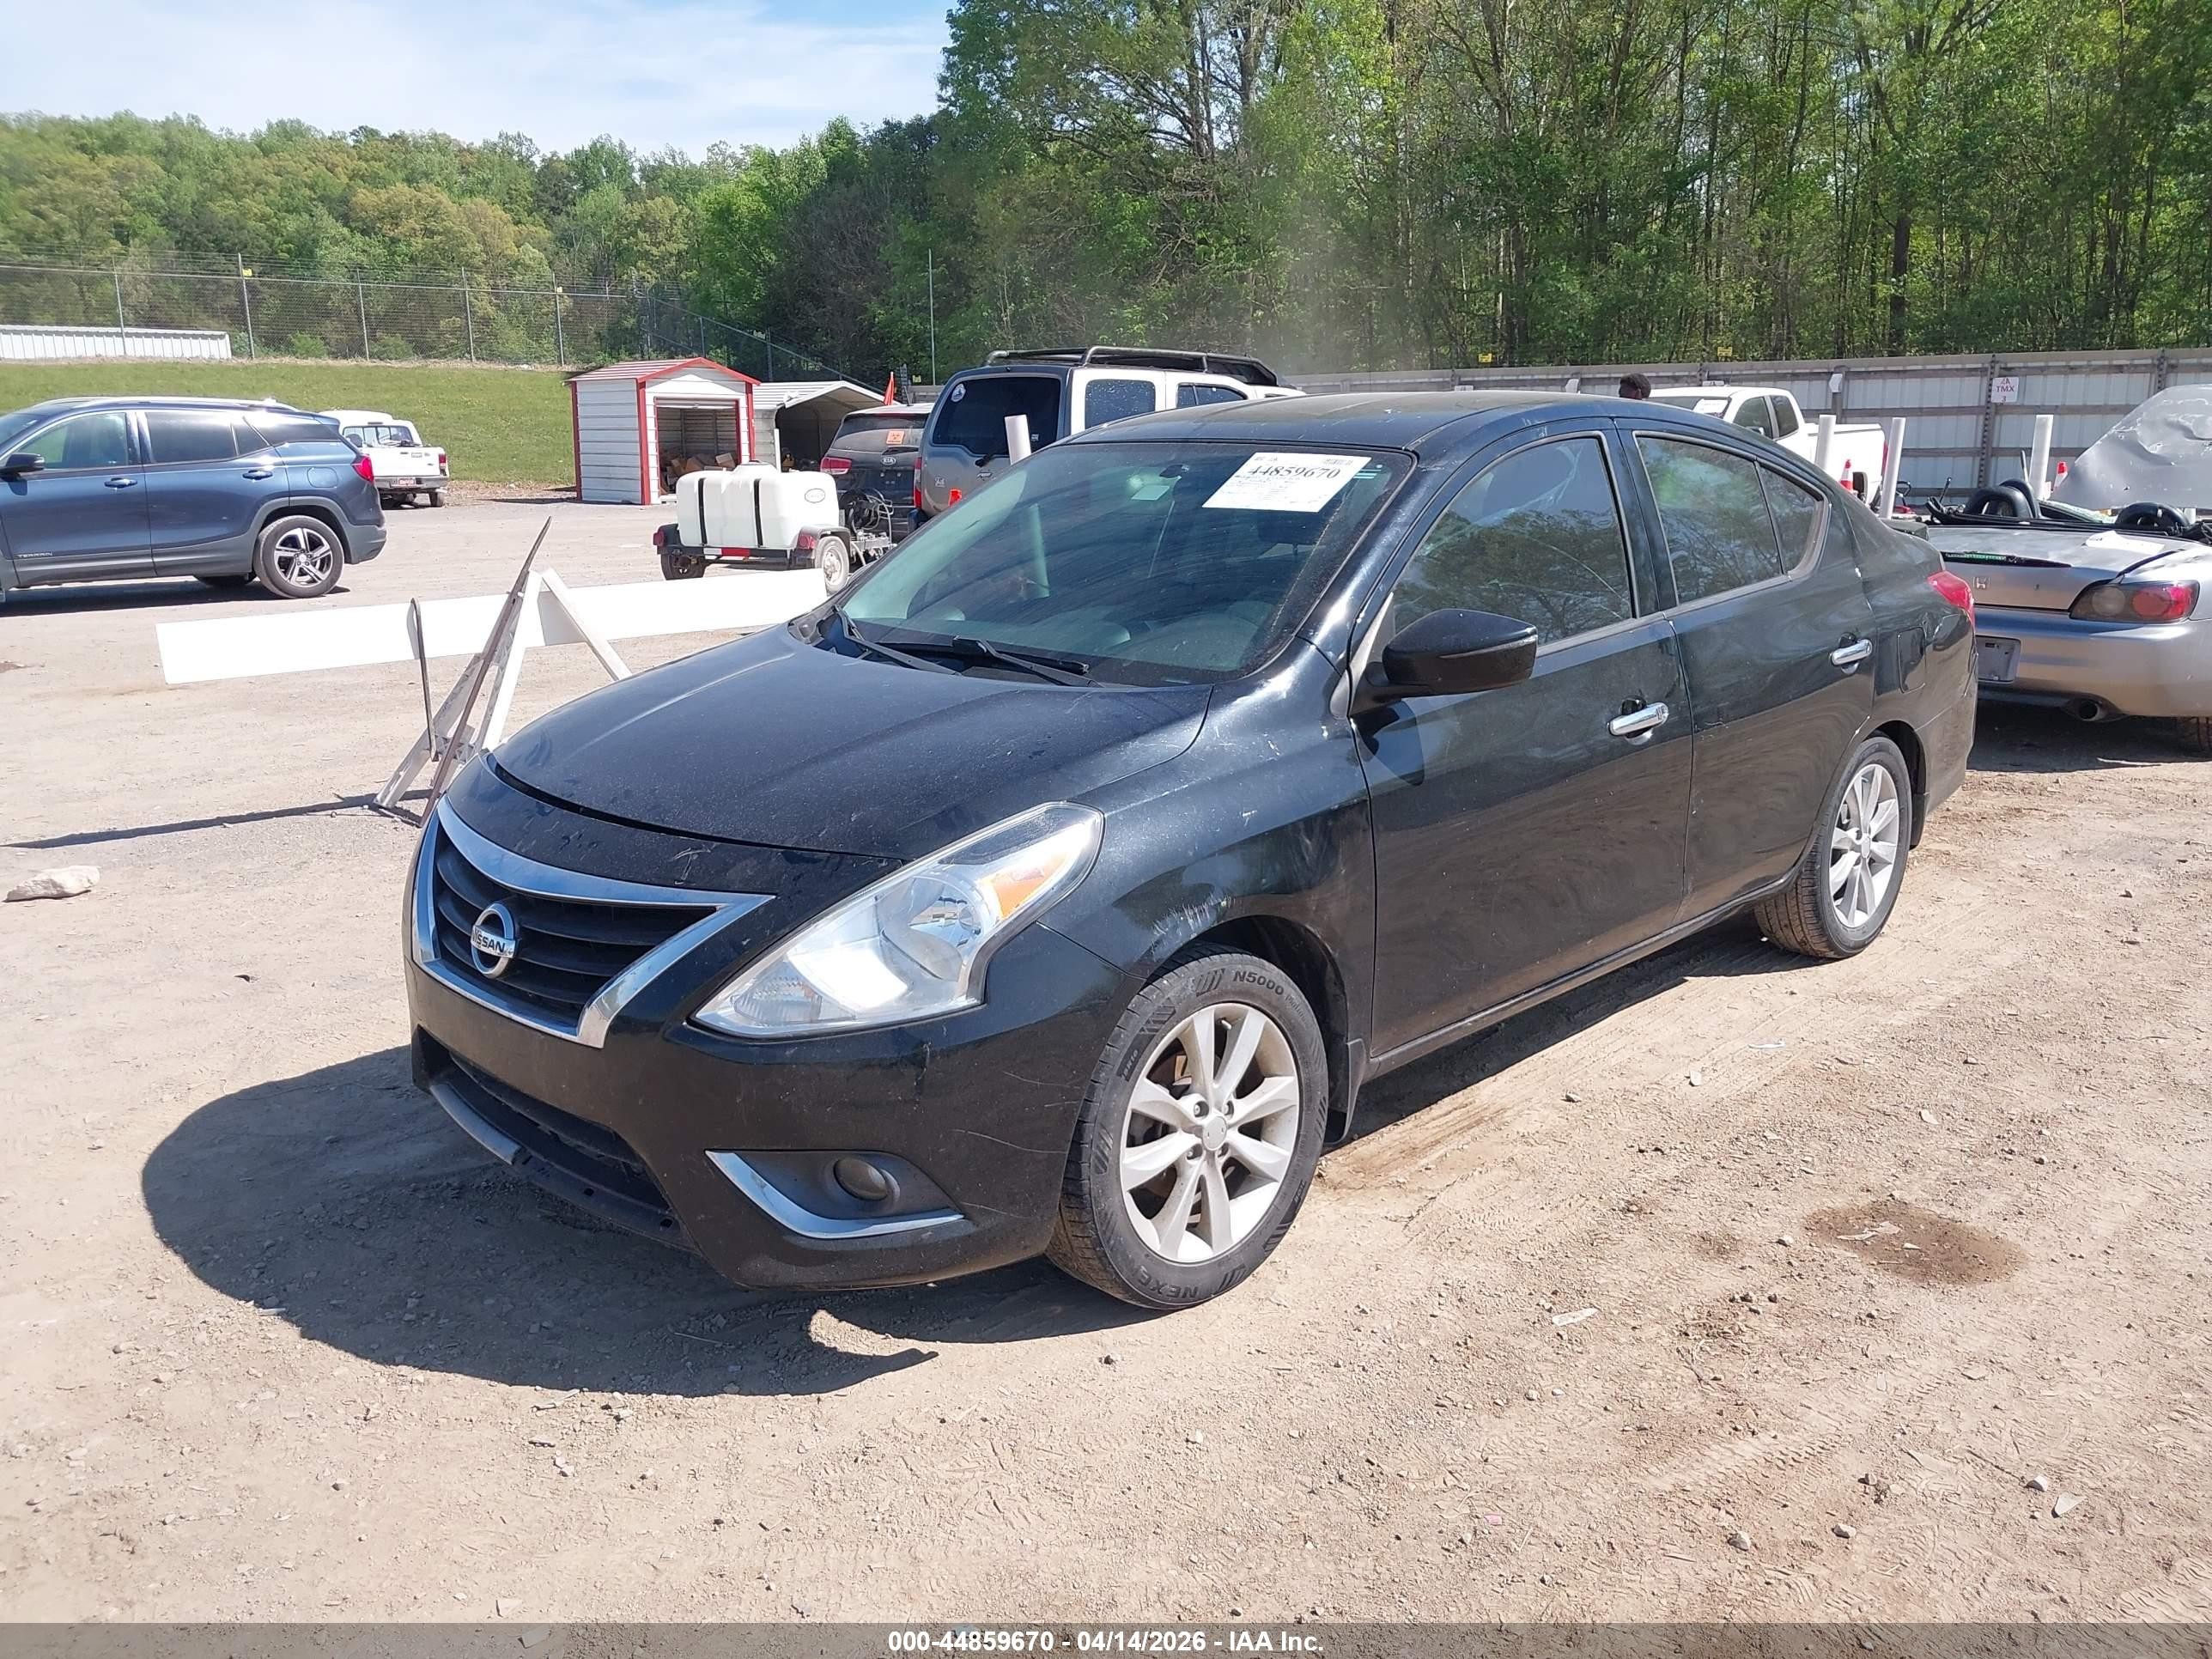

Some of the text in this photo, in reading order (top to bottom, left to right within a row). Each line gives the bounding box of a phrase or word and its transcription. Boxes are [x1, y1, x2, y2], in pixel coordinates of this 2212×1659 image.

[1248, 465, 1341, 479] 44859670
[472, 930, 506, 953] NISSAN
[1233, 970, 1285, 995] N5000
